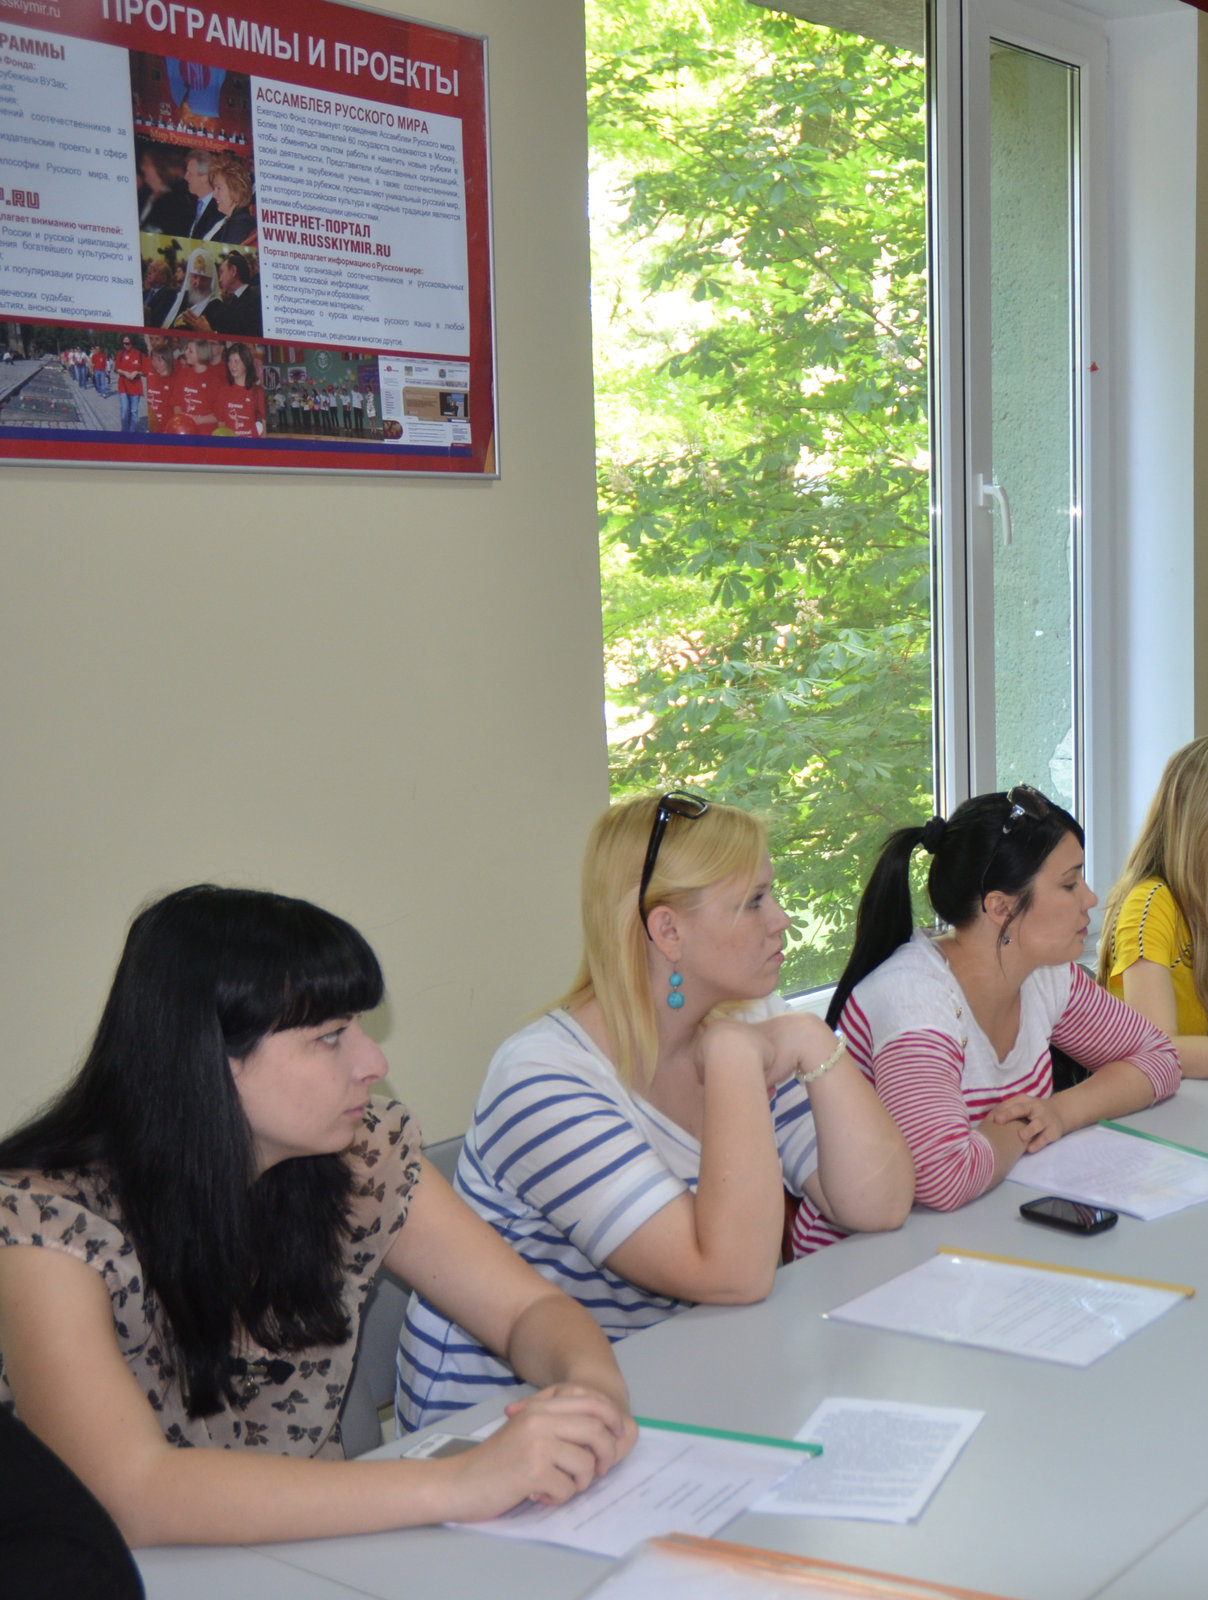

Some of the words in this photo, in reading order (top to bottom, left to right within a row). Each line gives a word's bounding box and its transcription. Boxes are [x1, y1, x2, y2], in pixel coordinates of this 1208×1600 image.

[0, 32, 65, 60] РАММЫ
[102, 0, 299, 63] ПРОГРАММЫ
[308, 36, 326, 68] И
[334, 43, 460, 97] ПРОЕКТЫ
[256, 86, 331, 115] АССАМБЛЕЯ
[335, 102, 394, 127] РУССКОГО
[397, 115, 428, 134] МИРА
[31, 113, 111, 133] соотечественников
[257, 118, 277, 129] Более
[280, 123, 295, 133] 1000
[297, 128, 346, 142] представителей
[59, 142, 90, 153] проекты
[104, 148, 127, 160] сфере
[258, 133, 277, 142] чтобы
[280, 136, 317, 149] обменяться
[320, 145, 343, 154] опытом
[347, 149, 368, 158] работы
[413, 136, 437, 147] Русского
[258, 146, 277, 155] своей
[326, 156, 372, 171] Представители
[259, 159, 294, 170] российские
[307, 168, 344, 178] зарубежные
[46, 162, 81, 175] Русского
[117, 175, 129, 183] его
[274, 187, 300, 196] которого
[303, 191, 336, 201] российская
[338, 197, 364, 207] культура
[422, 198, 445, 207] русский
[32, 217, 76, 228] вниманию
[261, 209, 370, 238] ИНТЕРНЕТ-ПОРТАЛ
[3, 226, 31, 237] России
[44, 233, 73, 242] русской
[262, 227, 391, 257] WWW.RUSSKIYMIR.RU
[23, 241, 72, 254] богатейшего
[78, 249, 123, 260] культурного
[263, 246, 288, 257] Портал
[289, 252, 326, 261] предлагает
[328, 256, 370, 267] информацию
[377, 261, 403, 271] Русском
[12, 266, 72, 278] популяризации
[75, 273, 108, 282] русского
[271, 262, 299, 270] каталоги
[304, 266, 342, 276] организаций
[347, 271, 403, 283] соотечественников
[272, 273, 296, 281] средств
[299, 276, 328, 285] массовой
[273, 284, 297, 292] новости
[298, 287, 325, 296] культуры
[273, 294, 328, 306] публицистические
[28, 304, 56, 312] анонсы
[274, 305, 314, 315] информацию
[328, 312, 347, 320] курсах
[353, 314, 379, 322] изучения
[384, 317, 409, 325] русского
[275, 327, 306, 336] авторские
